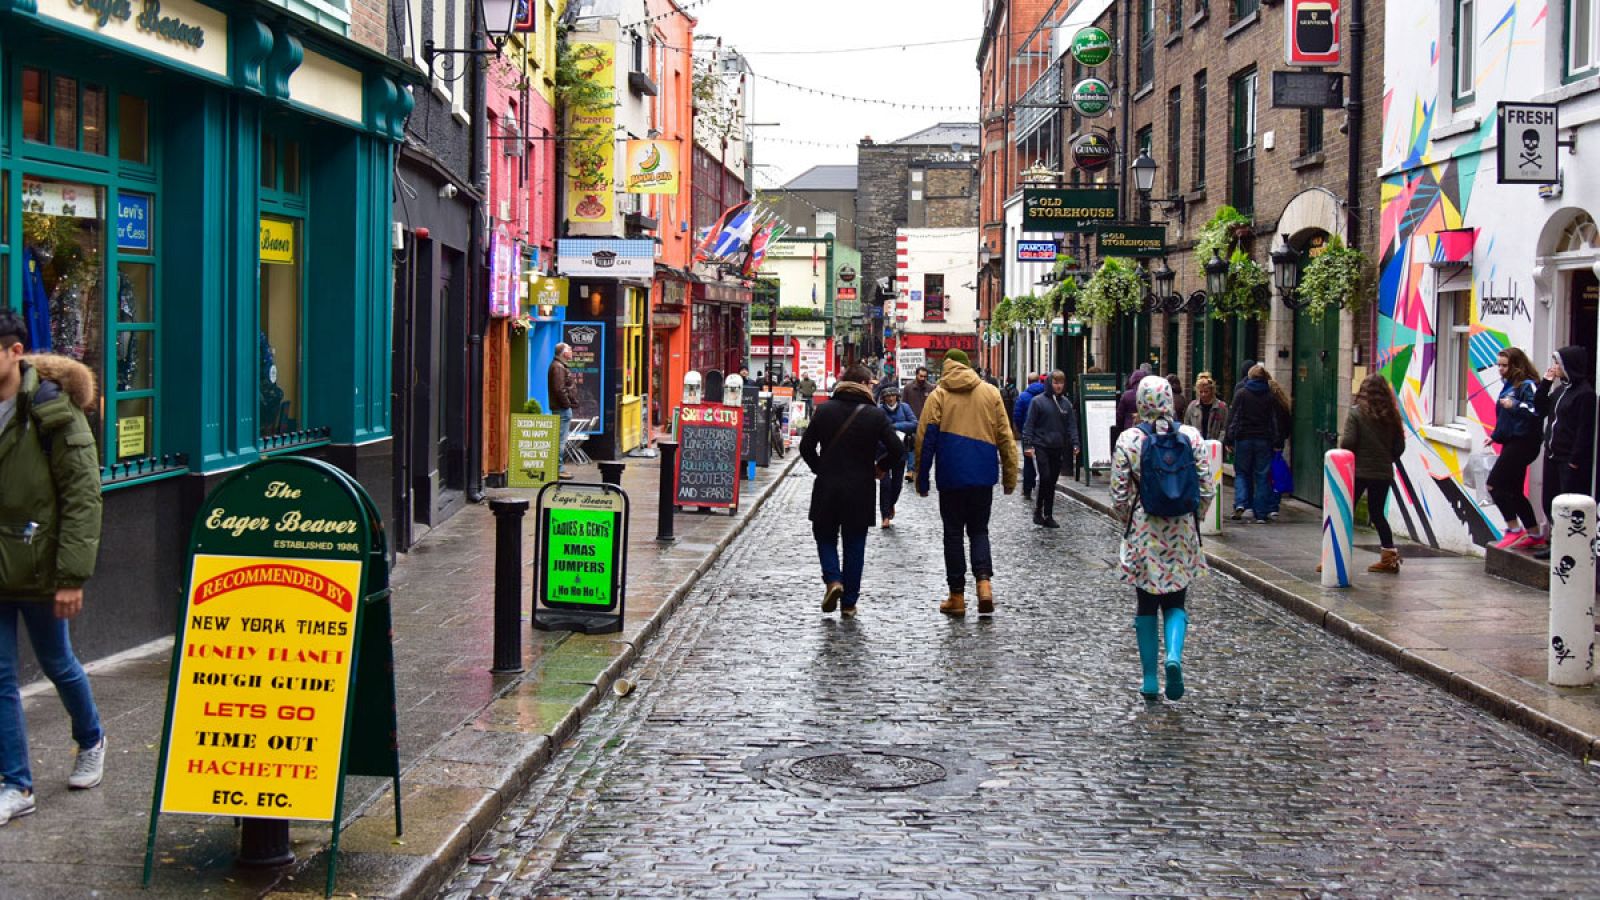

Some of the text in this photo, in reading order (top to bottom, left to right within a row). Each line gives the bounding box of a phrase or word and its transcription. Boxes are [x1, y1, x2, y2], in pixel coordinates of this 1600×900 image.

[67, 0, 131, 27] ager
[1507, 109, 1554, 125] FRESH
[1075, 146, 1110, 154] GUINNESS
[1039, 197, 1062, 206] OLD
[118, 202, 144, 220] Levi's
[1028, 207, 1115, 218] STOREHOUSE
[1102, 239, 1161, 247] STOREHOUSE
[714, 408, 738, 426] CITY
[681, 472, 733, 485] SCOOTERS
[264, 481, 303, 499] The
[679, 487, 697, 498] AND
[205, 508, 357, 537] Eager Beaver
[273, 540, 333, 550] ESTABLISHED
[563, 543, 596, 556] XMAS
[553, 560, 605, 573] JUMPERS
[202, 568, 347, 604] RECOMMENDED BY
[583, 586, 594, 597] Ho
[192, 616, 348, 636] NEW YORK TIMES
[188, 644, 346, 665] LONELY PLANET
[192, 672, 336, 693] ROUGH GUIDE
[203, 702, 316, 721] LETS GO
[195, 731, 318, 752] TIME OUT
[188, 759, 318, 780] HACHETTE
[212, 790, 293, 808] ETC. ETC.
